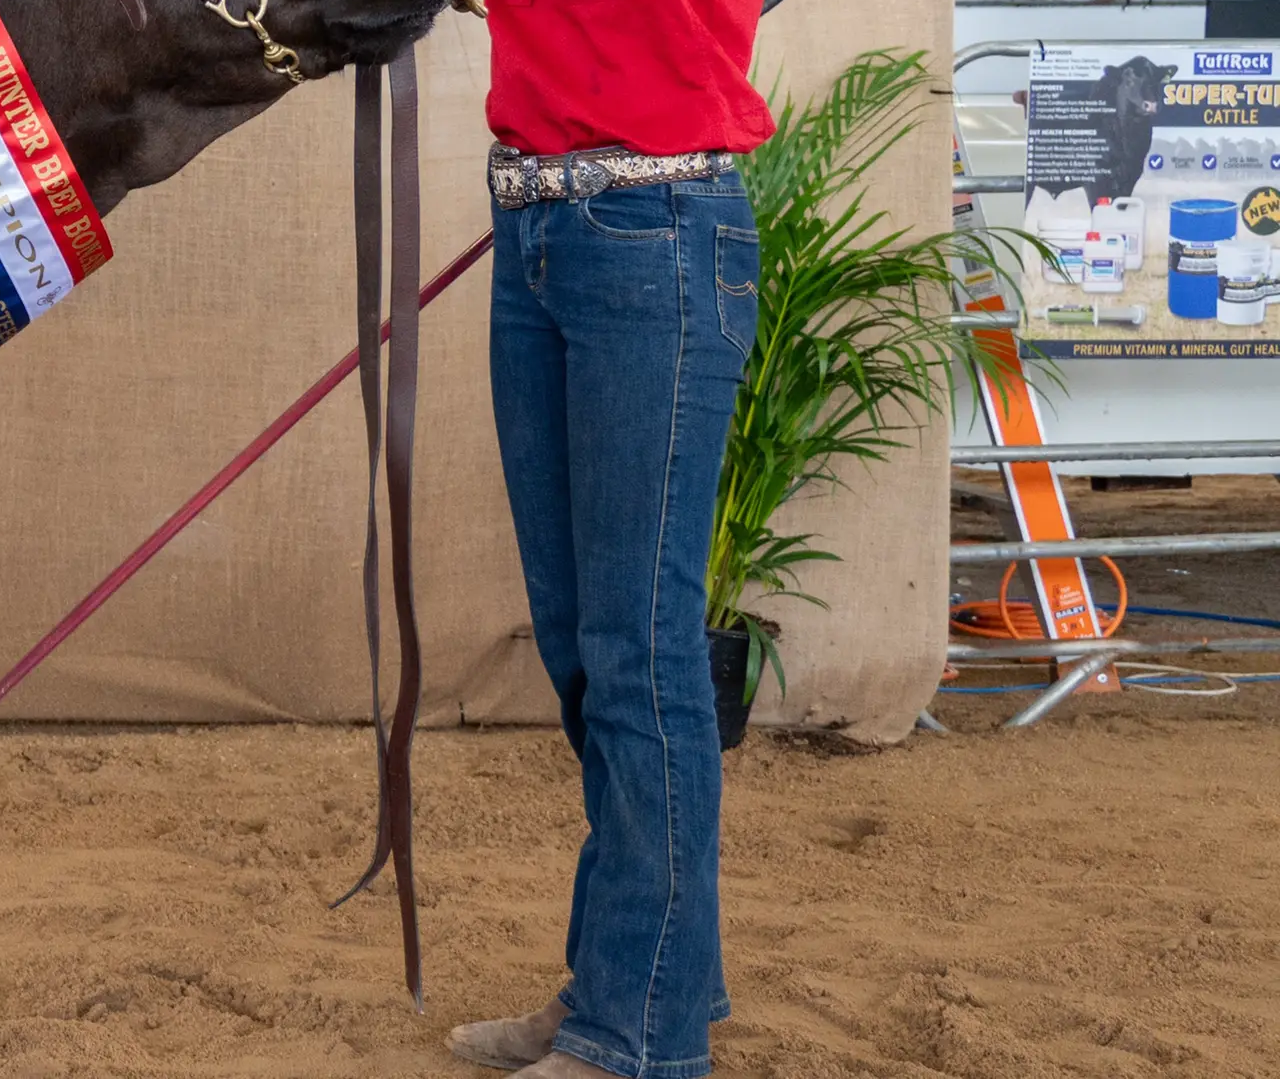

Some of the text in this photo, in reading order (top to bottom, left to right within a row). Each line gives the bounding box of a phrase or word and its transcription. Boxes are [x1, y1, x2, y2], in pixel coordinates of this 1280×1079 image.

[1196, 53, 1269, 70] TuffRock
[1203, 108, 1259, 125] CATTLE
[32, 155, 82, 217] BEEF
[1249, 199, 1280, 219] NEW
[1073, 343, 1122, 356] PREMIUM
[1124, 343, 1167, 356] VITAMIN
[1169, 343, 1178, 356] &
[1181, 343, 1226, 356] MINERAL
[1229, 343, 1251, 356] GUT
